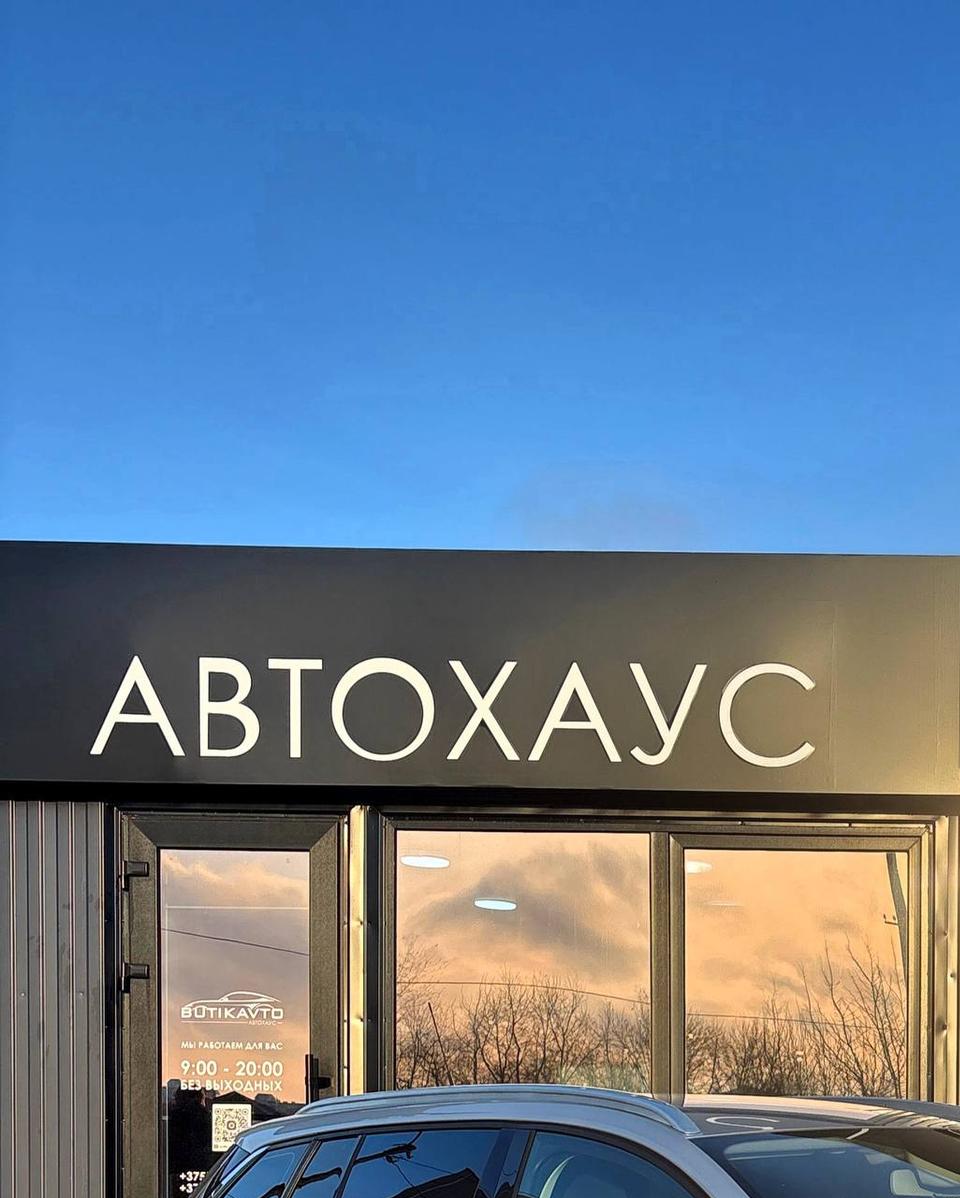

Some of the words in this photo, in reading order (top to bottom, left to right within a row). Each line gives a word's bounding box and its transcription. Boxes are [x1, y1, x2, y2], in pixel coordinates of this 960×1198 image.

[90, 655, 816, 767] АВТОХАУС
[181, 1007, 284, 1019] BUTIKAVTO
[181, 1041, 196, 1049] МЫ
[198, 1041, 243, 1050] РАБОТАЕМ
[245, 1042, 263, 1050] ДЛЯ
[265, 1042, 283, 1050] ВАС
[181, 1060, 217, 1076] 9:00
[235, 1060, 283, 1076] 20:00
[180, 1080, 201, 1091] БЕЗ
[205, 1080, 283, 1092] ВЫХОДНЫХ
